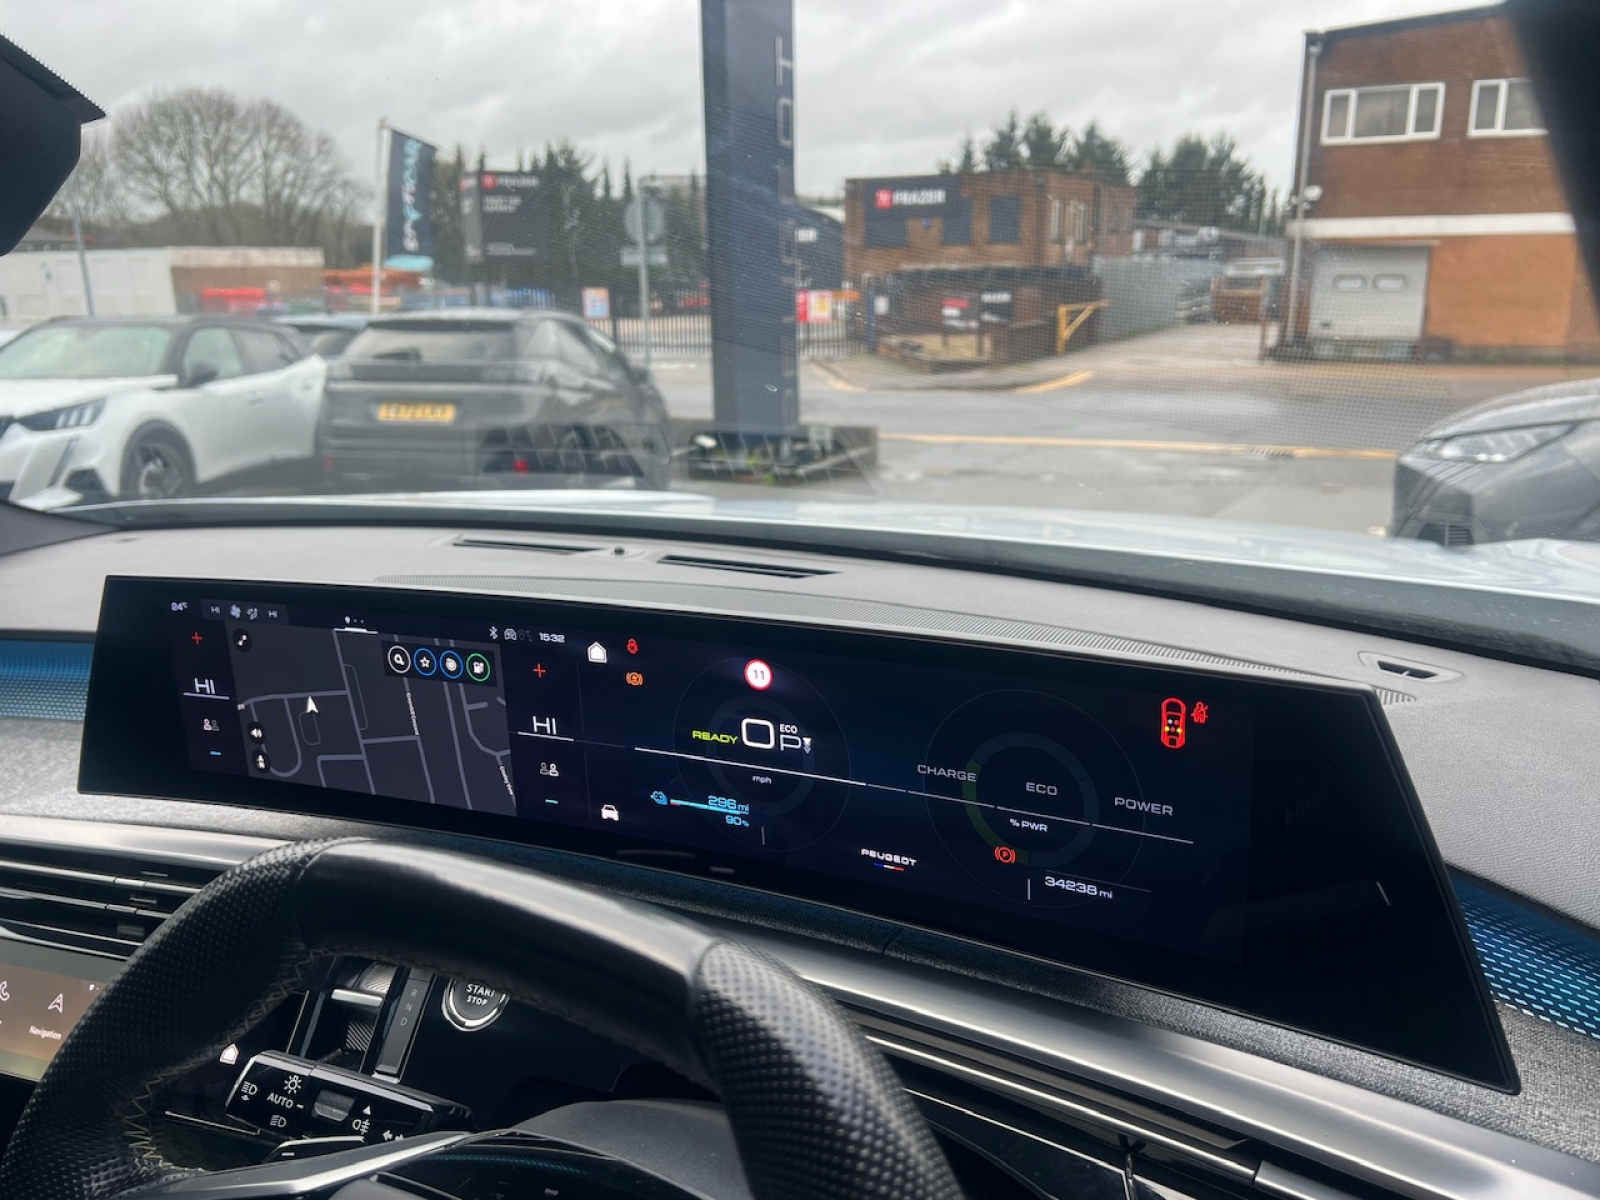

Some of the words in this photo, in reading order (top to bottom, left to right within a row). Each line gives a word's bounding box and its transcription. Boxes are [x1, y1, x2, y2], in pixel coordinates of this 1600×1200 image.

[194, 677, 216, 695] HI
[532, 715, 557, 735] HI
[779, 724, 799, 735] ECO
[692, 730, 739, 745] READY
[779, 734, 803, 752] P
[752, 775, 772, 784] mph
[916, 764, 977, 783] CHARGE
[1025, 782, 1058, 796] ECO
[707, 795, 737, 810] 296
[738, 804, 750, 812] mi
[1114, 797, 1174, 816] POWER
[1009, 818, 1021, 828] %
[1021, 820, 1049, 833] PWR
[860, 848, 917, 867] PEUGEOT
[1044, 876, 1099, 896] 34238
[1099, 889, 1114, 900] mi
[466, 995, 488, 1006] STOP
[28, 1025, 62, 1041] Navigation
[266, 1091, 294, 1109] AUTO
